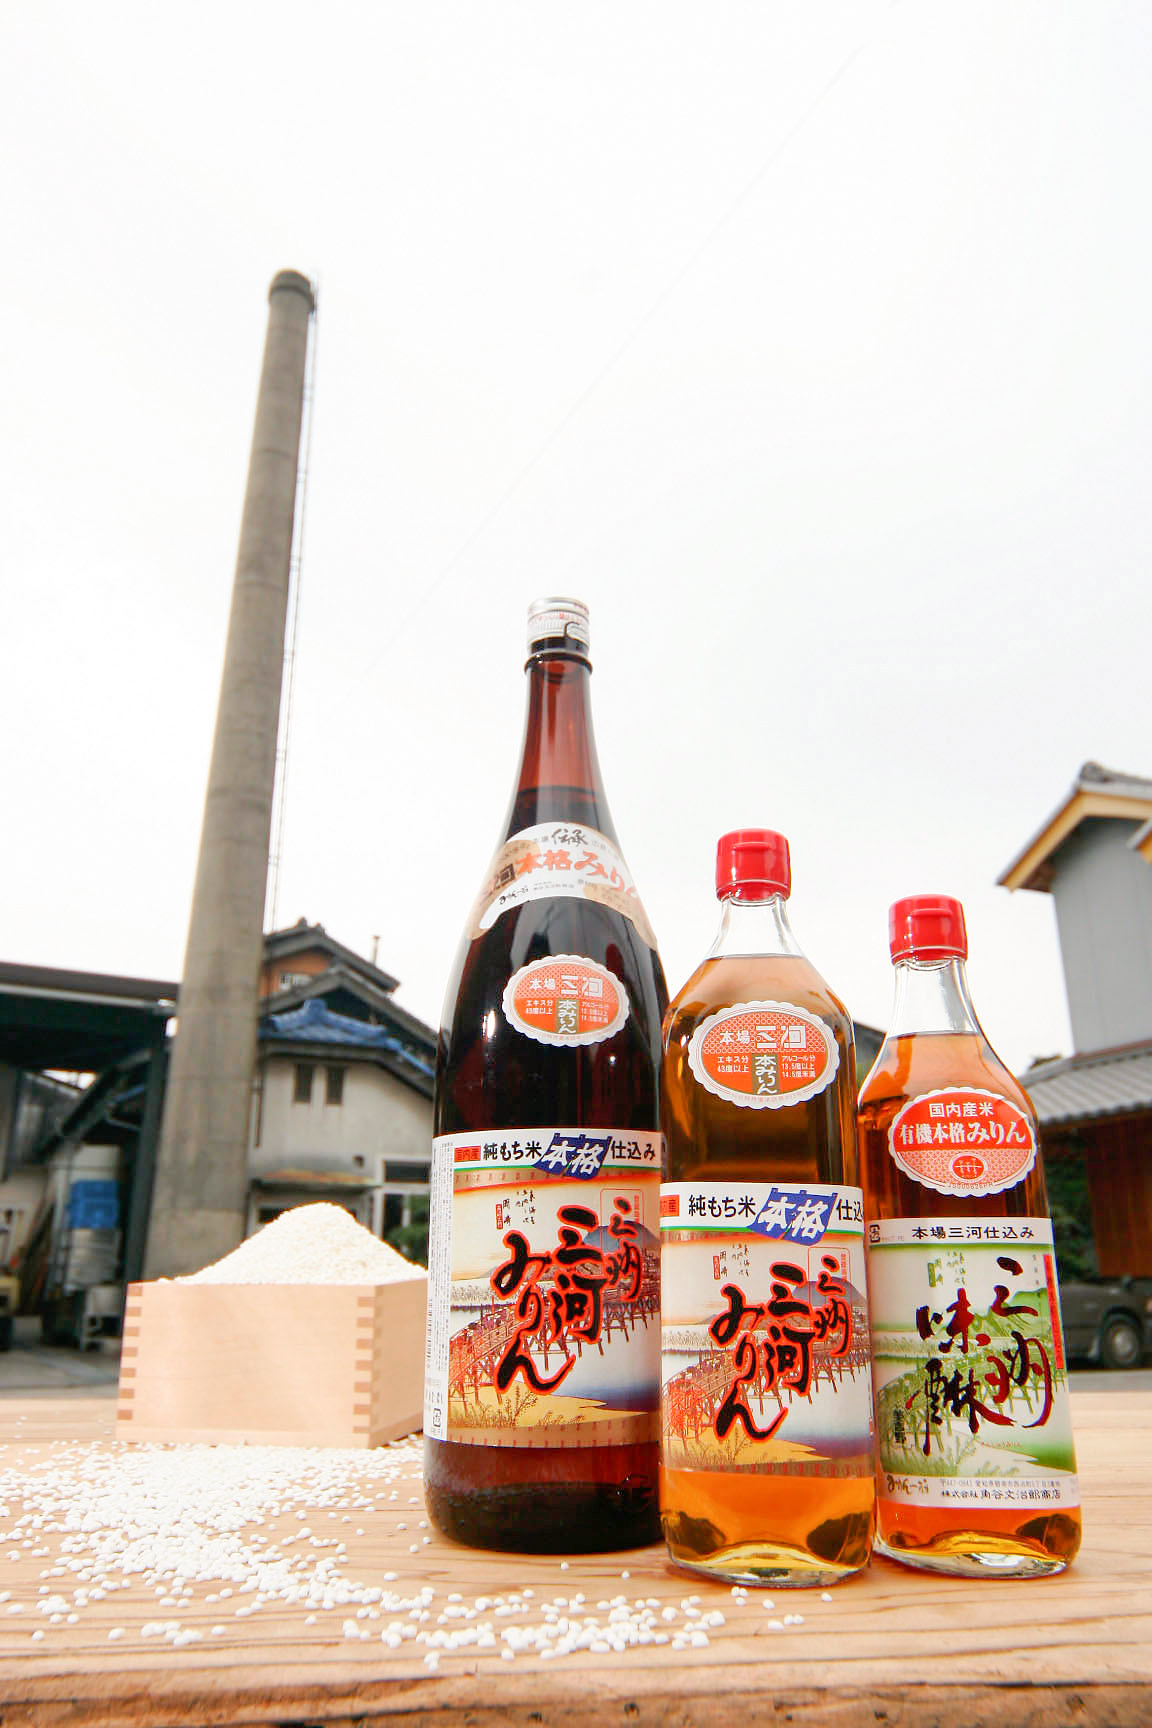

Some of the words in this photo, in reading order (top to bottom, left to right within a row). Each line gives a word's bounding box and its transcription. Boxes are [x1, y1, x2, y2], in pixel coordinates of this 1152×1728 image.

[529, 978, 556, 991] 本場
[558, 999, 577, 1034] 本みりん
[719, 1030, 751, 1045] 本場
[717, 1056, 749, 1064] エキス分
[754, 1054, 777, 1095] 本みりん
[928, 1102, 995, 1118] 国内産米
[900, 1120, 1027, 1145] 有機本格みりん
[483, 1140, 543, 1161] 純もち米
[541, 1140, 604, 1176] 本格
[611, 1140, 656, 1160] 仕込み
[688, 1194, 757, 1218] 純もち米
[757, 1195, 828, 1239] 本格
[911, 1225, 1035, 1240] 本場三河仕込み
[490, 1230, 577, 1395] みりん
[708, 1282, 789, 1444] みりん
